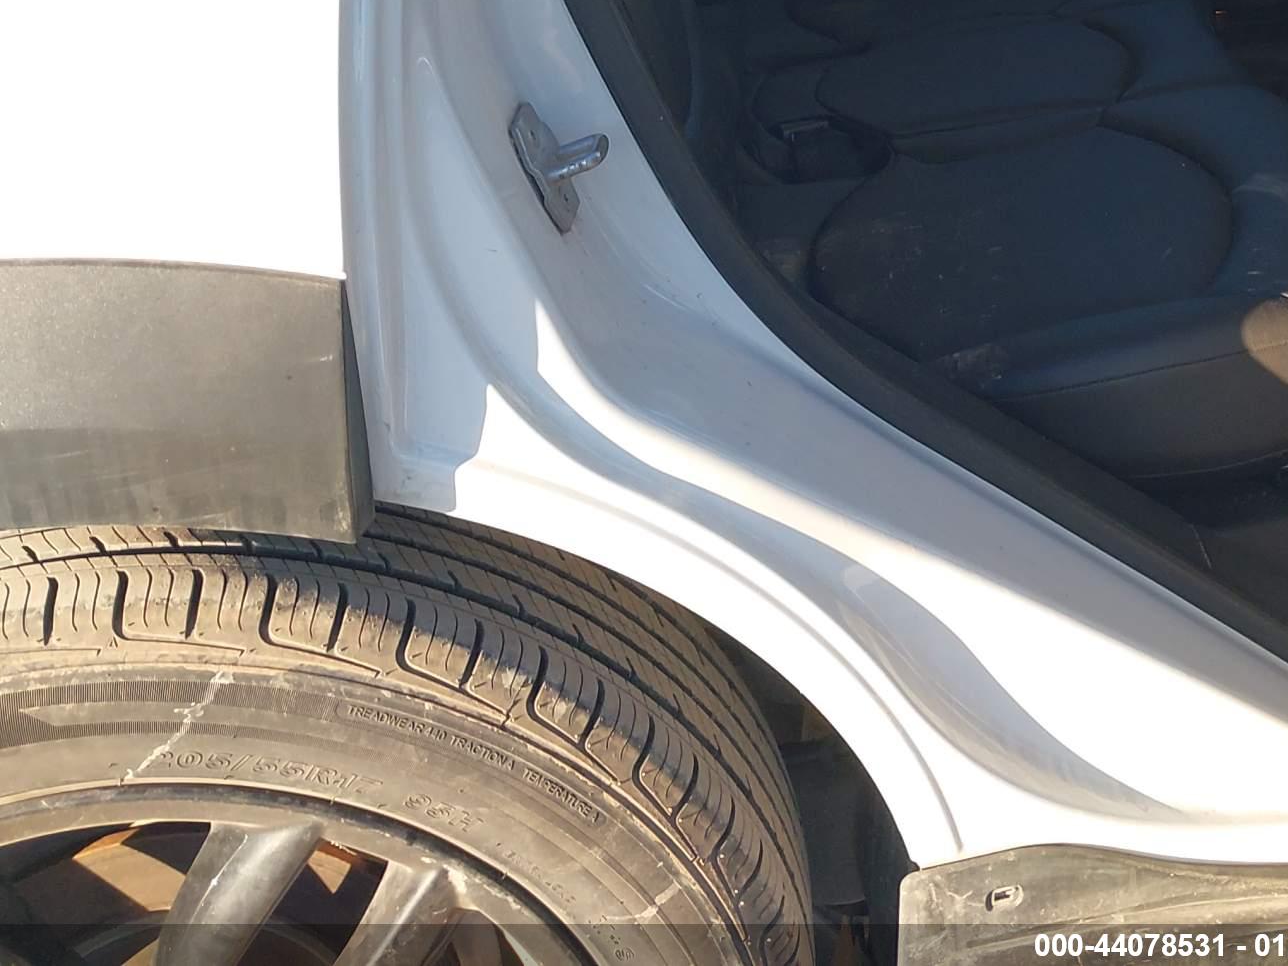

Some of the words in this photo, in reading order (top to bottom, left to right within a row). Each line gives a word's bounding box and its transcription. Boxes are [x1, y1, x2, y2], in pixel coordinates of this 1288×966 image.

[347, 704, 425, 734] TREADWEAR
[450, 735, 508, 769] TRACTION
[505, 758, 516, 772] A
[521, 767, 594, 819] TEMPERATURE
